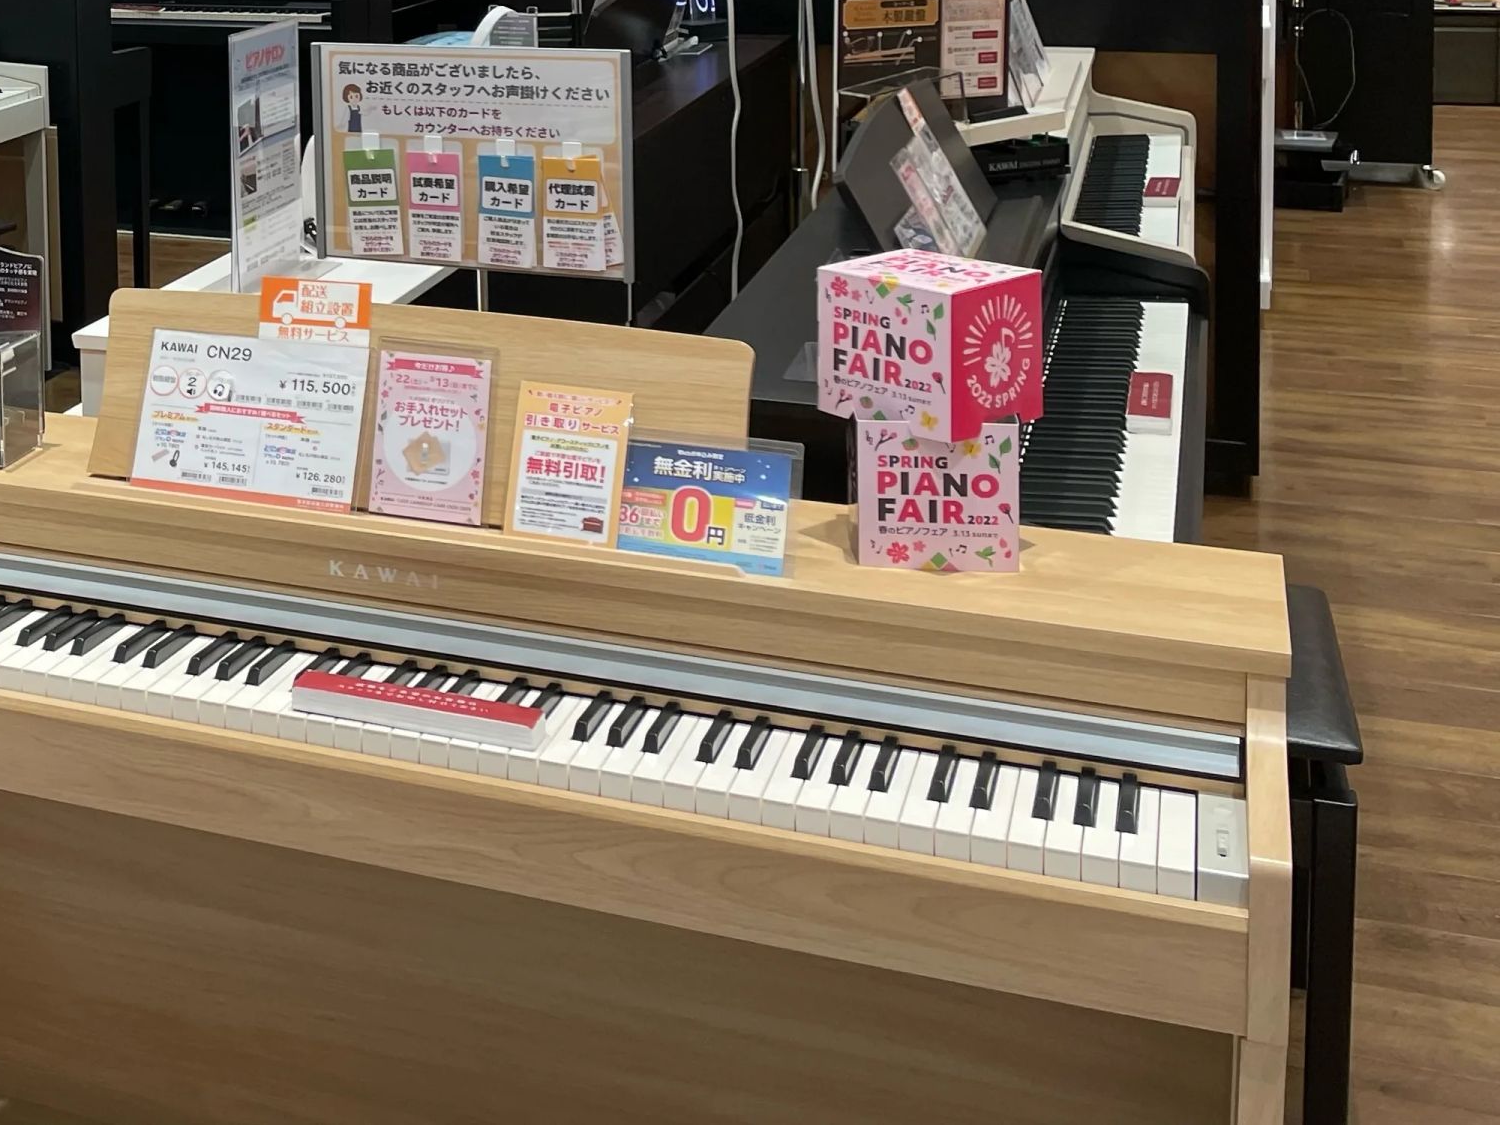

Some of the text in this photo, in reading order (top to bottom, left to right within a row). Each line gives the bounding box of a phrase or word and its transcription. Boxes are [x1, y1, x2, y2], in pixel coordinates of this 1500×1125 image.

[337, 61, 541, 81] 気になる商品がございましたら、
[365, 80, 610, 102] お近くのスタッフへお声掛けください
[381, 105, 502, 120] もしくは以下のカードを
[414, 122, 560, 139] カウンターへお持ちください
[350, 174, 392, 186] 商品説明
[485, 180, 529, 196] 購入希望
[357, 187, 389, 198] カード
[418, 190, 451, 203] カード
[490, 196, 524, 209] カード
[555, 197, 589, 210] カード
[301, 284, 327, 299] 配送
[300, 299, 354, 317] 組立設置
[833, 306, 891, 329] SPRING
[277, 325, 350, 343] 無料サービス
[833, 322, 933, 364] PIANO
[160, 340, 253, 362] KAWAI CN29
[833, 348, 932, 393] FAIR 2022
[833, 376, 888, 396] 春のピアノフェア
[966, 358, 1031, 409] 2022 SPRING
[394, 401, 468, 419] お手入れセット
[549, 403, 604, 417] 電子ピアノ
[399, 415, 460, 432] プレゼント!
[526, 456, 606, 485] 無料引取!
[654, 456, 713, 482] 無金利
[877, 455, 948, 469] SPRING
[877, 471, 999, 498] PIANO
[671, 486, 726, 546] 0 円
[744, 512, 776, 526] 低金利
[878, 497, 998, 525] FAIR 2022
[738, 524, 781, 535] キャンペーン
[878, 526, 947, 537] 春のピアノフェア
[953, 529, 970, 538] 3.13
[329, 559, 438, 589] KAWAI
